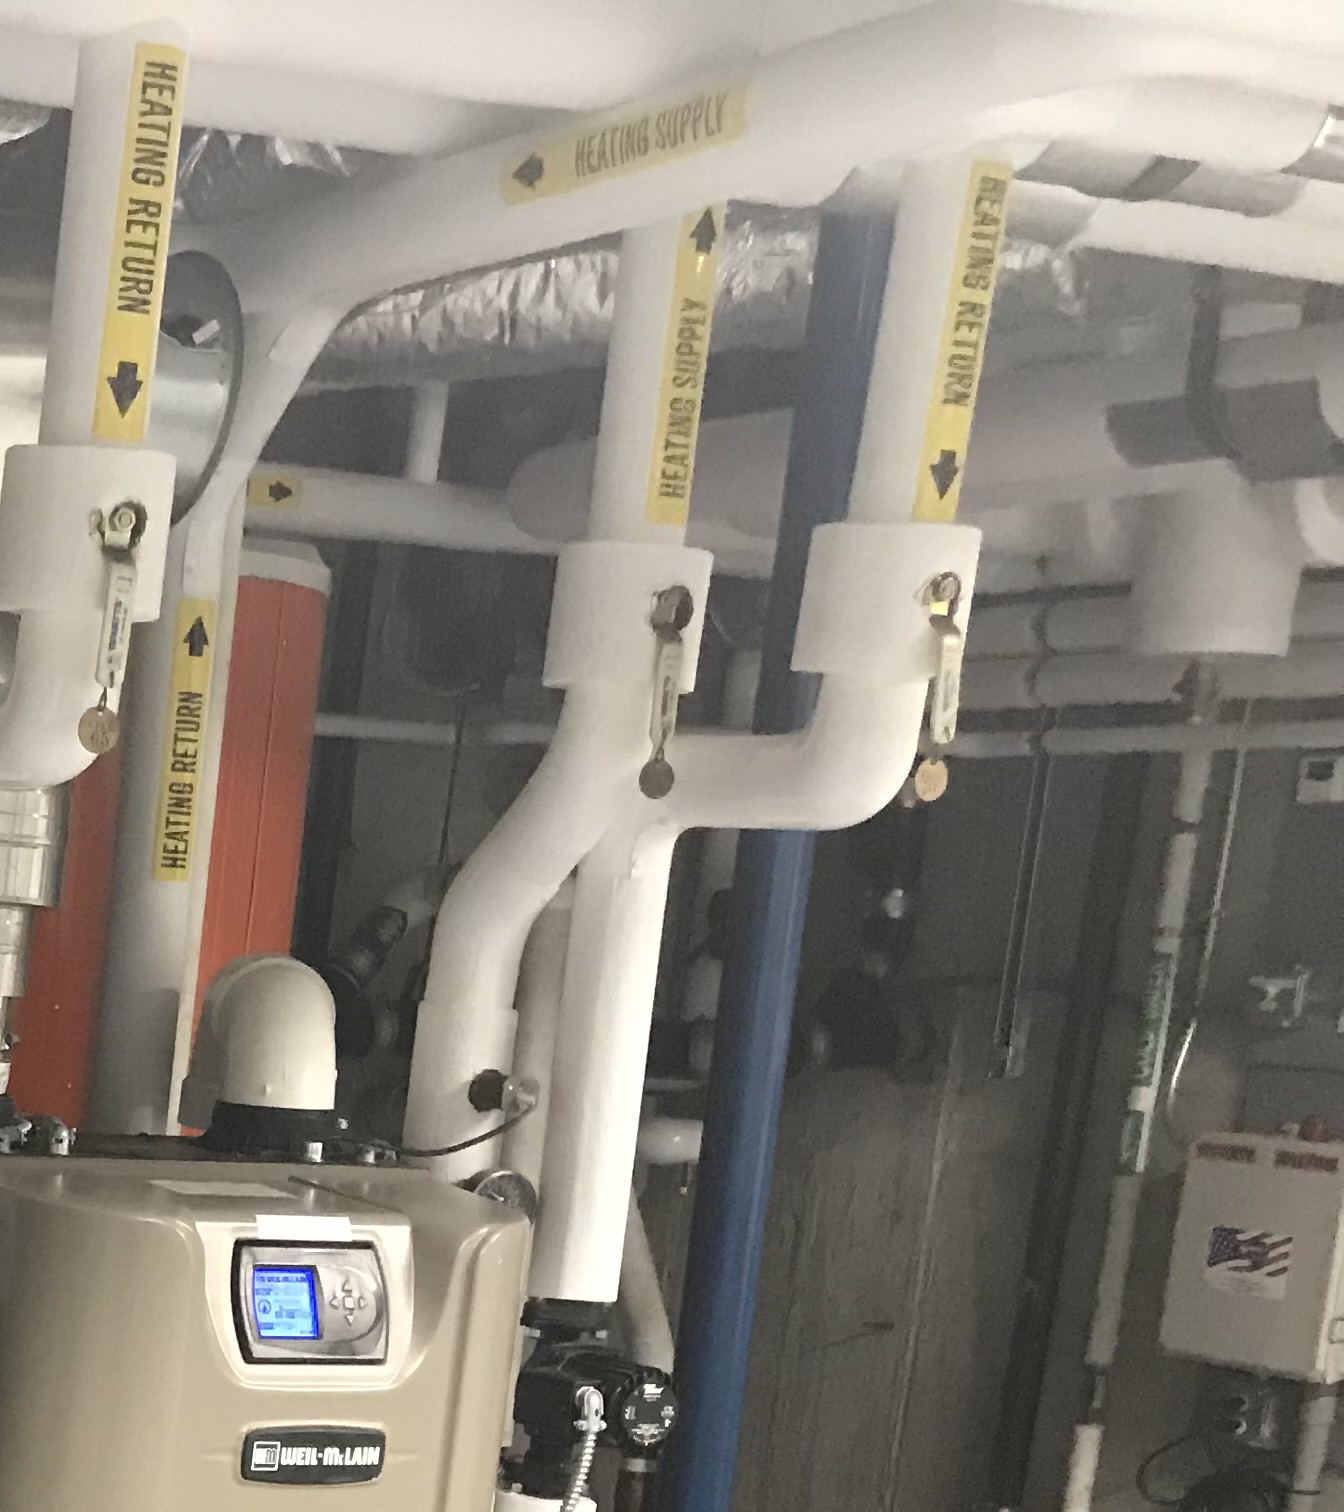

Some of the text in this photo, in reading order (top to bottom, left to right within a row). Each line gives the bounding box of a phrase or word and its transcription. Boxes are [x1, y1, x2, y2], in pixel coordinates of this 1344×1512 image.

[117, 60, 178, 316] HEATING RETURN
[574, 92, 731, 178] HEATING SUPPLY
[659, 297, 709, 499] HEATING SUPPLY
[942, 300, 986, 406] RETURN
[161, 690, 203, 869] HEATING RETURN
